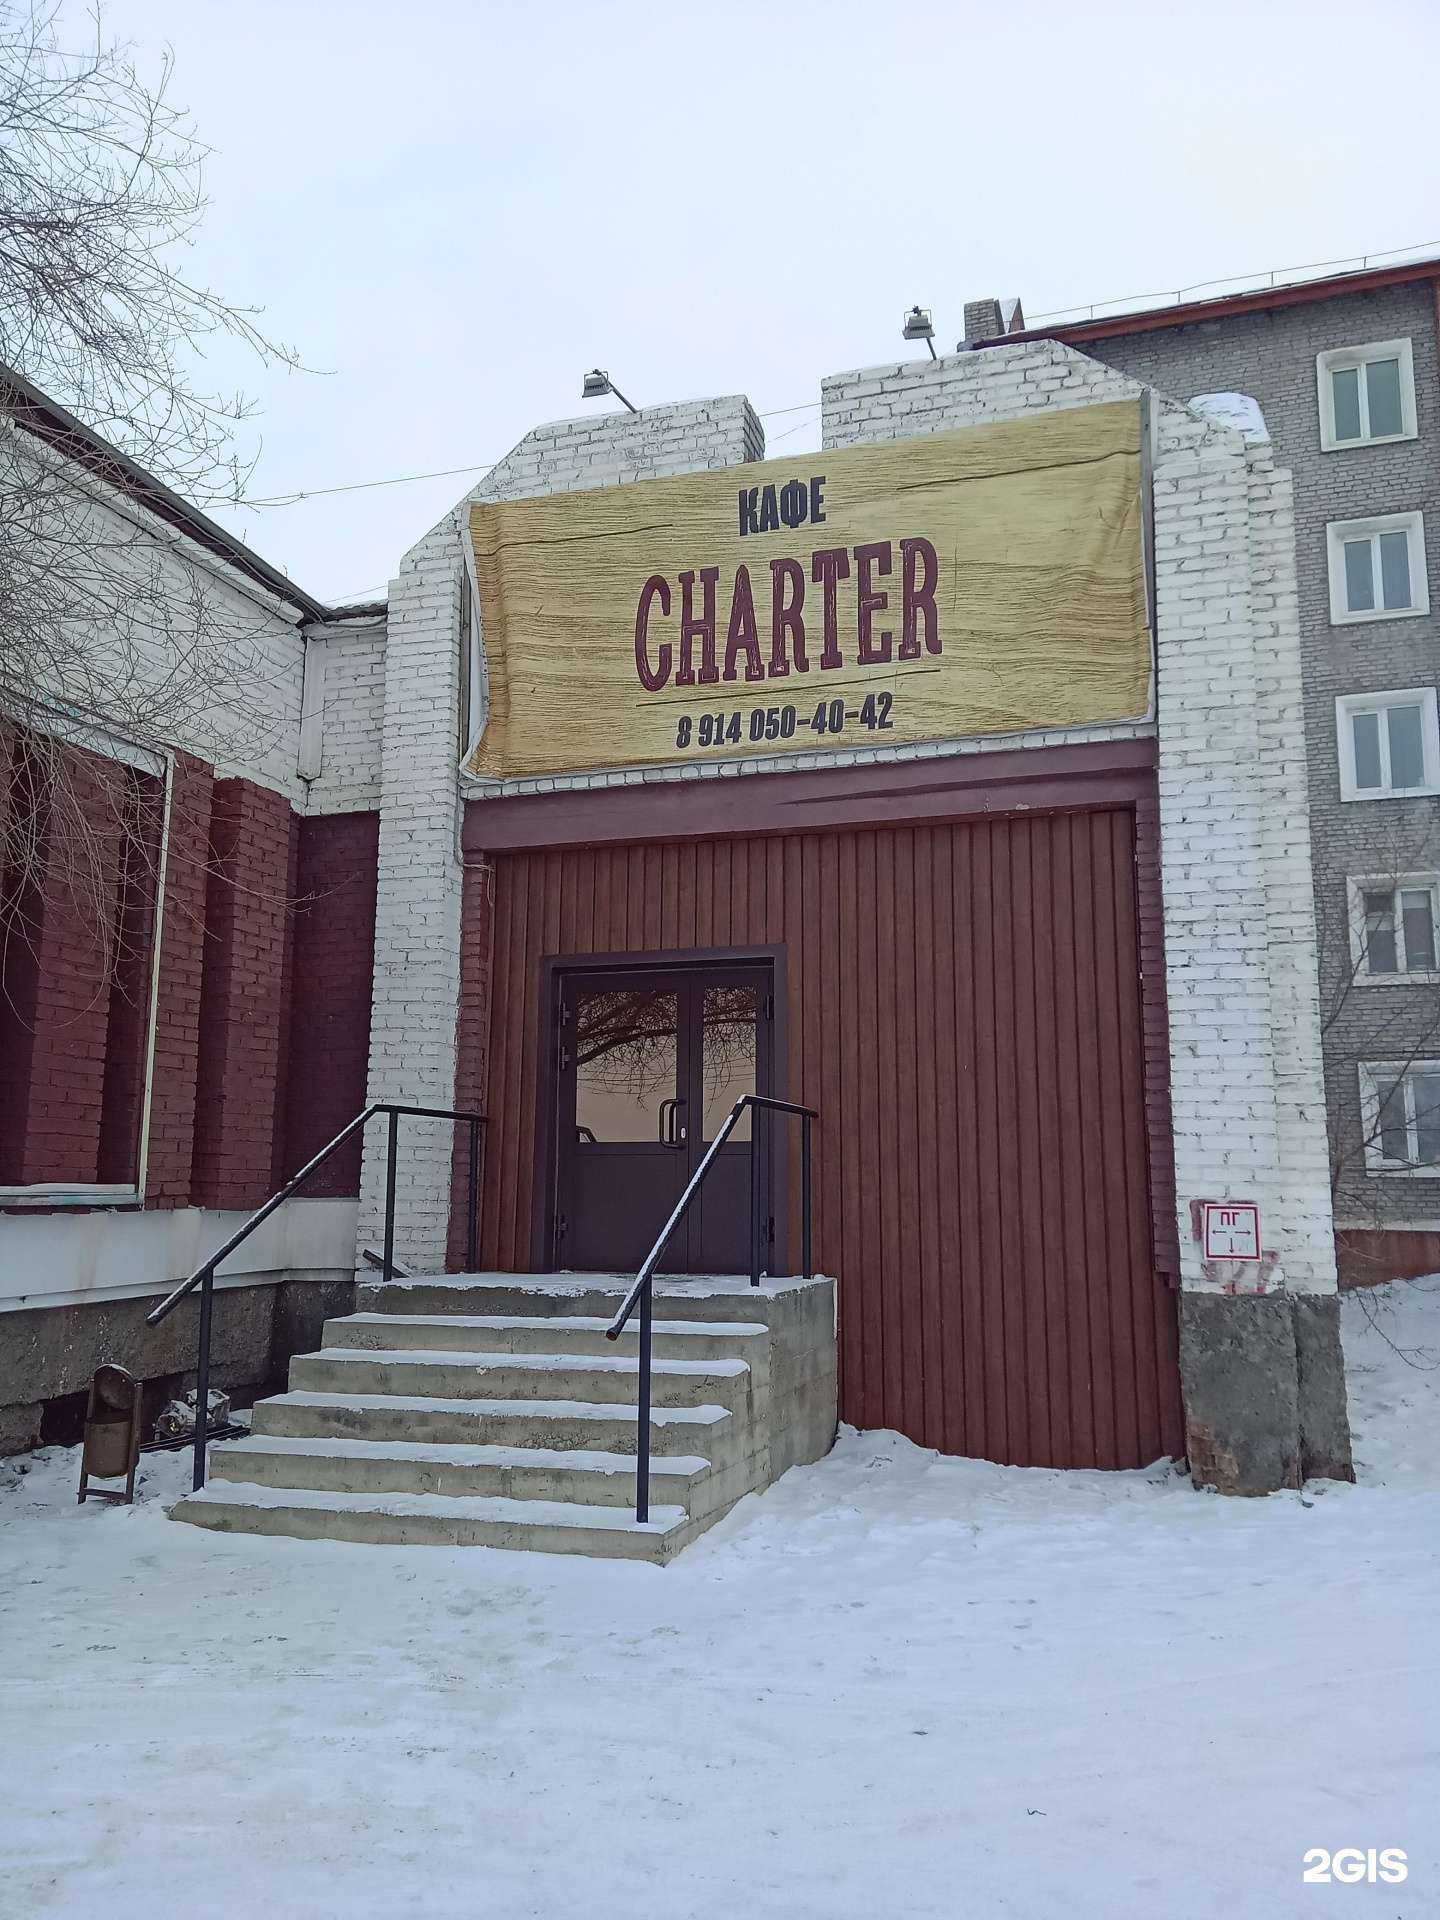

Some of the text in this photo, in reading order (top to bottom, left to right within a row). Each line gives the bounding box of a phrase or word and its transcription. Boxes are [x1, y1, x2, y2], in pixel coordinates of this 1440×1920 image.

[739, 476, 827, 536] КАФЕ
[635, 537, 943, 692] CHARTER
[676, 691, 894, 748] 8 914 050-40-42
[1220, 1211, 1240, 1226] ПГ
